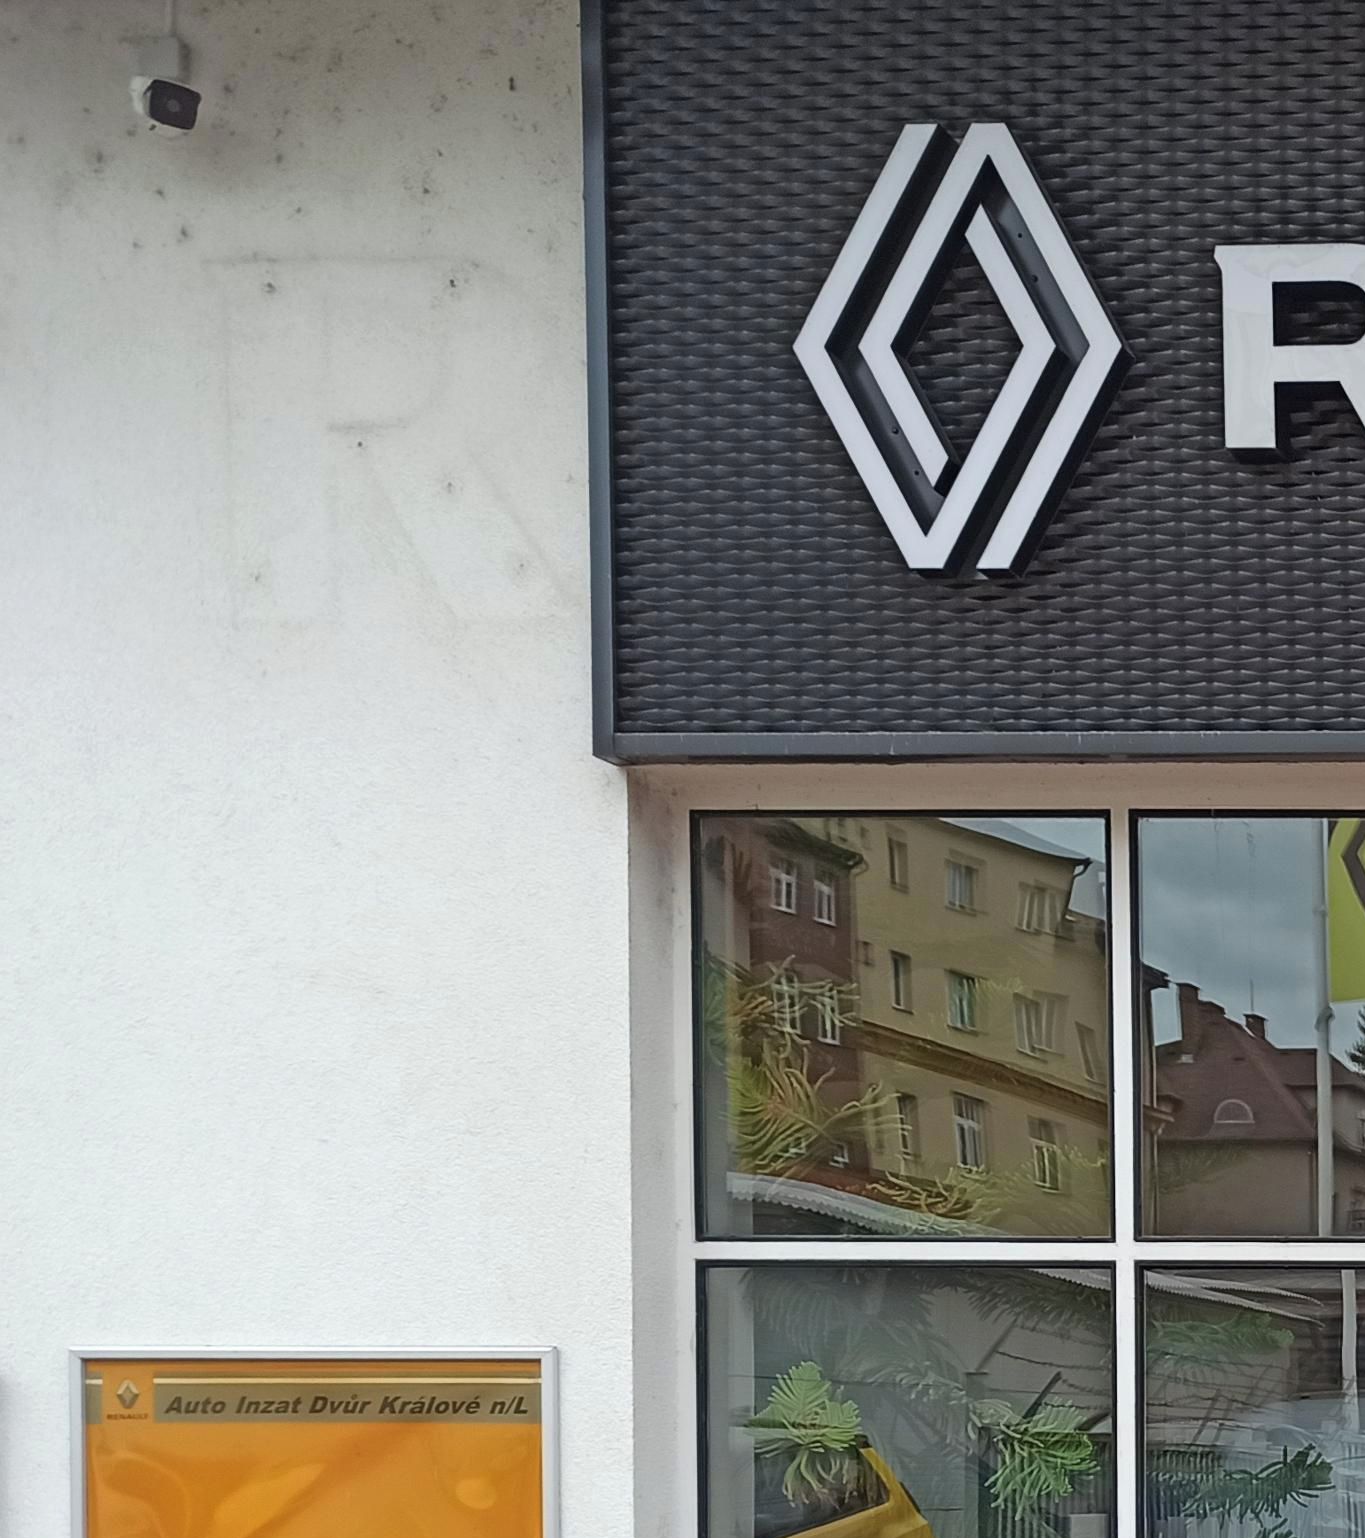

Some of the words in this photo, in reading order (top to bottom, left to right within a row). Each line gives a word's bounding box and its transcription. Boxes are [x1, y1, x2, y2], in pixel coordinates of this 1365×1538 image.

[164, 1396, 226, 1414] Auto
[235, 1396, 302, 1414] Inzat
[308, 1393, 371, 1414] Dvůr
[378, 1393, 481, 1414] Králové
[489, 1396, 529, 1414] n/L
